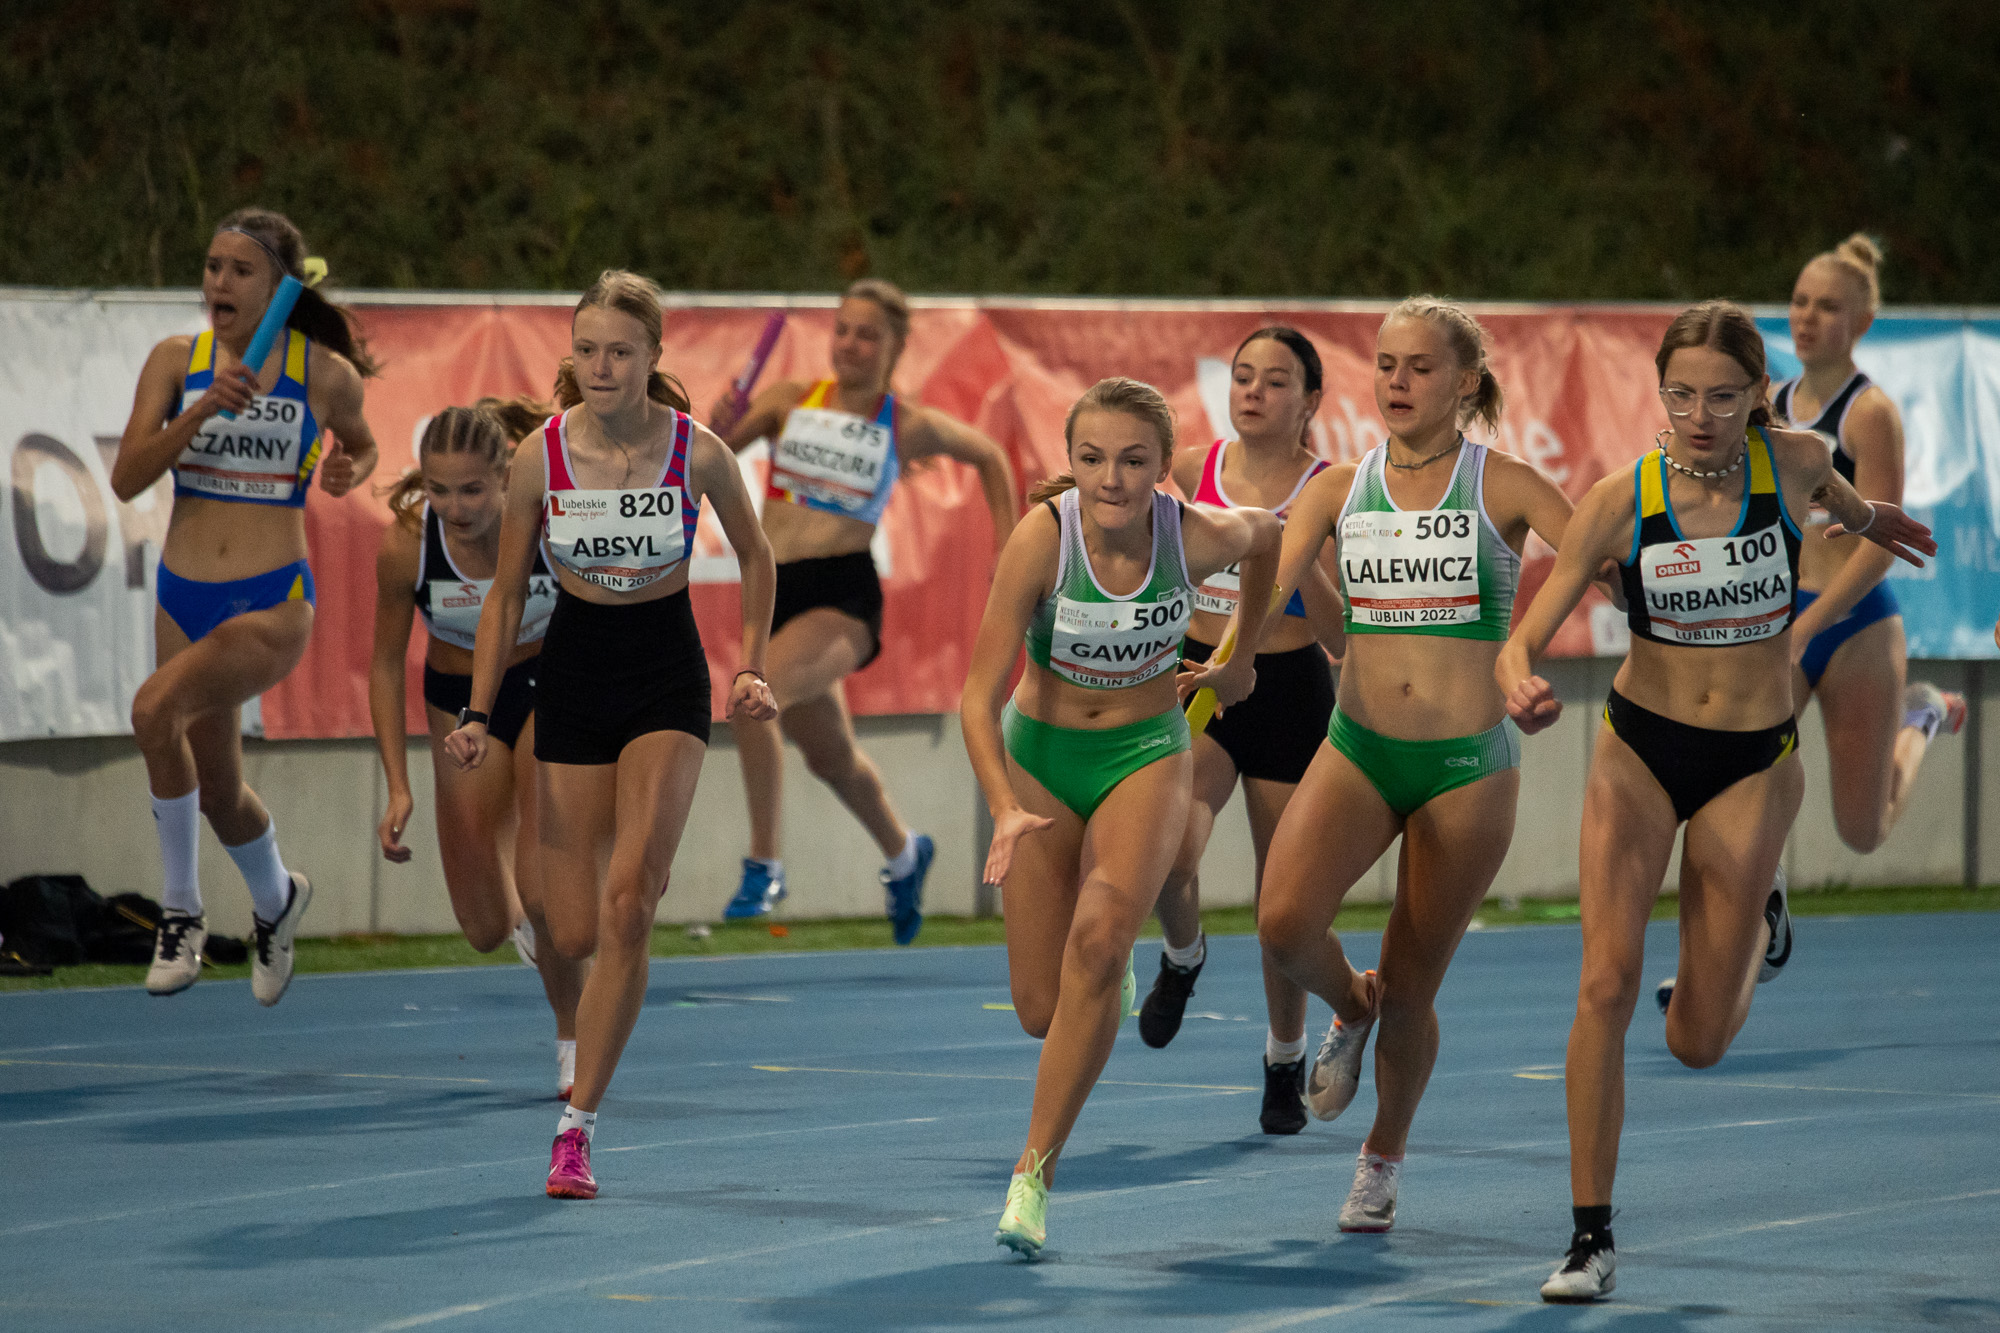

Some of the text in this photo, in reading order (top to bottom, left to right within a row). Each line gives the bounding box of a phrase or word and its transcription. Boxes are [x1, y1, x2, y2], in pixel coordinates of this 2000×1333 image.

[247, 400, 296, 423] 550
[188, 433, 291, 461] CZARNY
[244, 482, 276, 494] 2022
[620, 491, 674, 518] 820
[1415, 514, 1470, 540] 503
[572, 535, 661, 558] ABSYL
[1723, 532, 1777, 567] 100
[1346, 557, 1473, 584] LALEWICZ
[1657, 562, 1698, 577] ORLEN
[1651, 574, 1787, 613] URBAŃSKA
[1094, 620, 1109, 629] KIDS
[1133, 600, 1184, 631] 500
[1370, 608, 1457, 623] LUBLIN 2022
[1675, 623, 1772, 641] LUBLIN 2022
[1070, 636, 1172, 662] GAWIN
[1072, 673, 1123, 686] LUBLIN
[1127, 664, 1159, 685] 2022
